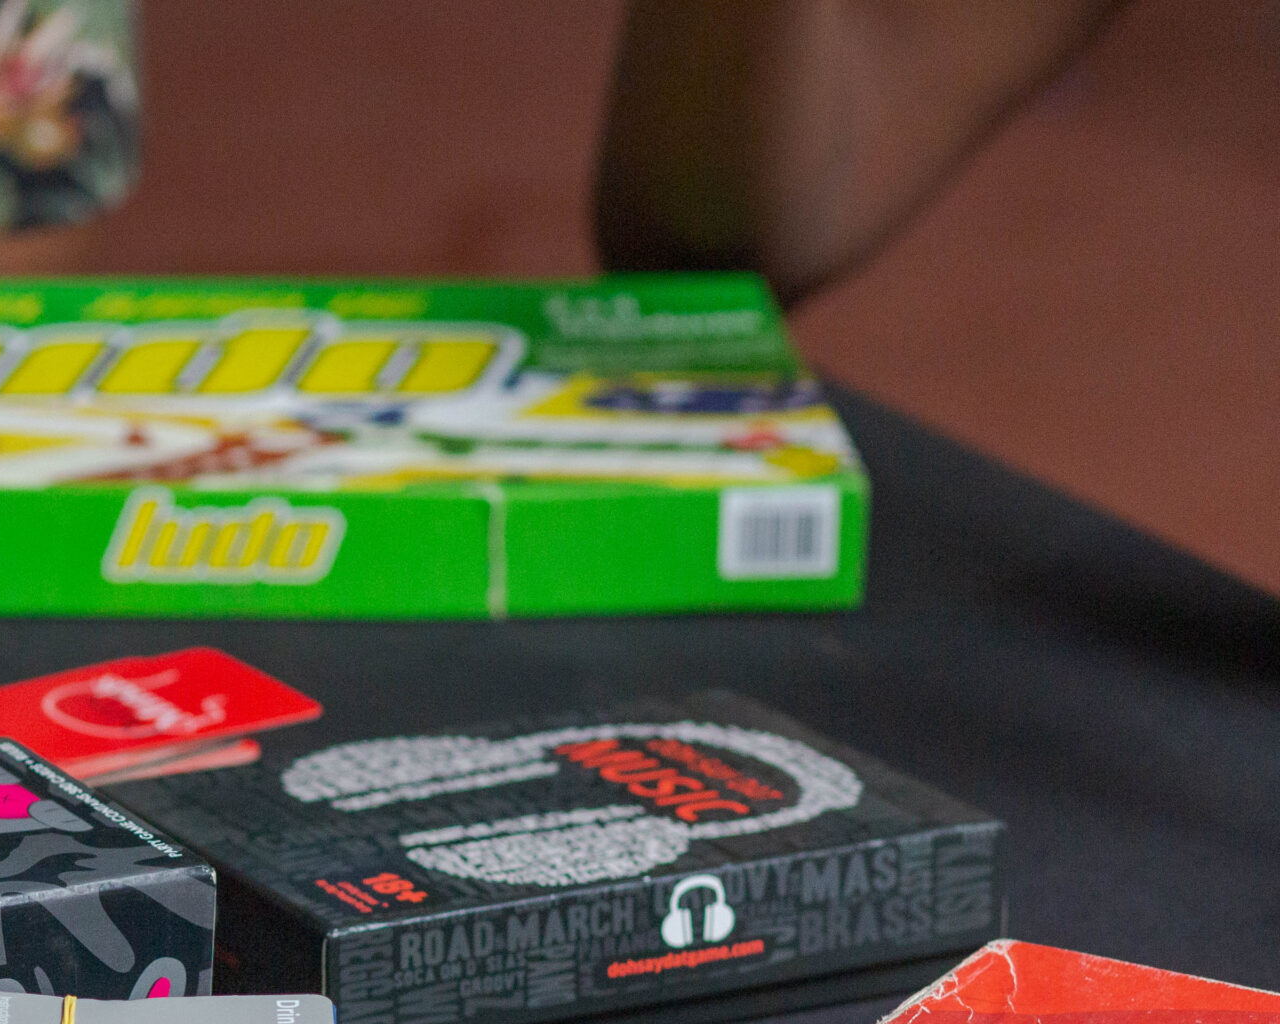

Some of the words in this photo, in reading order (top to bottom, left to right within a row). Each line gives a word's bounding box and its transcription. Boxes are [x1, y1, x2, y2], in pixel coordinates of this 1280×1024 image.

[108, 492, 339, 576] ludo
[399, 917, 495, 971] ROAD
[507, 892, 634, 952] MARCH
